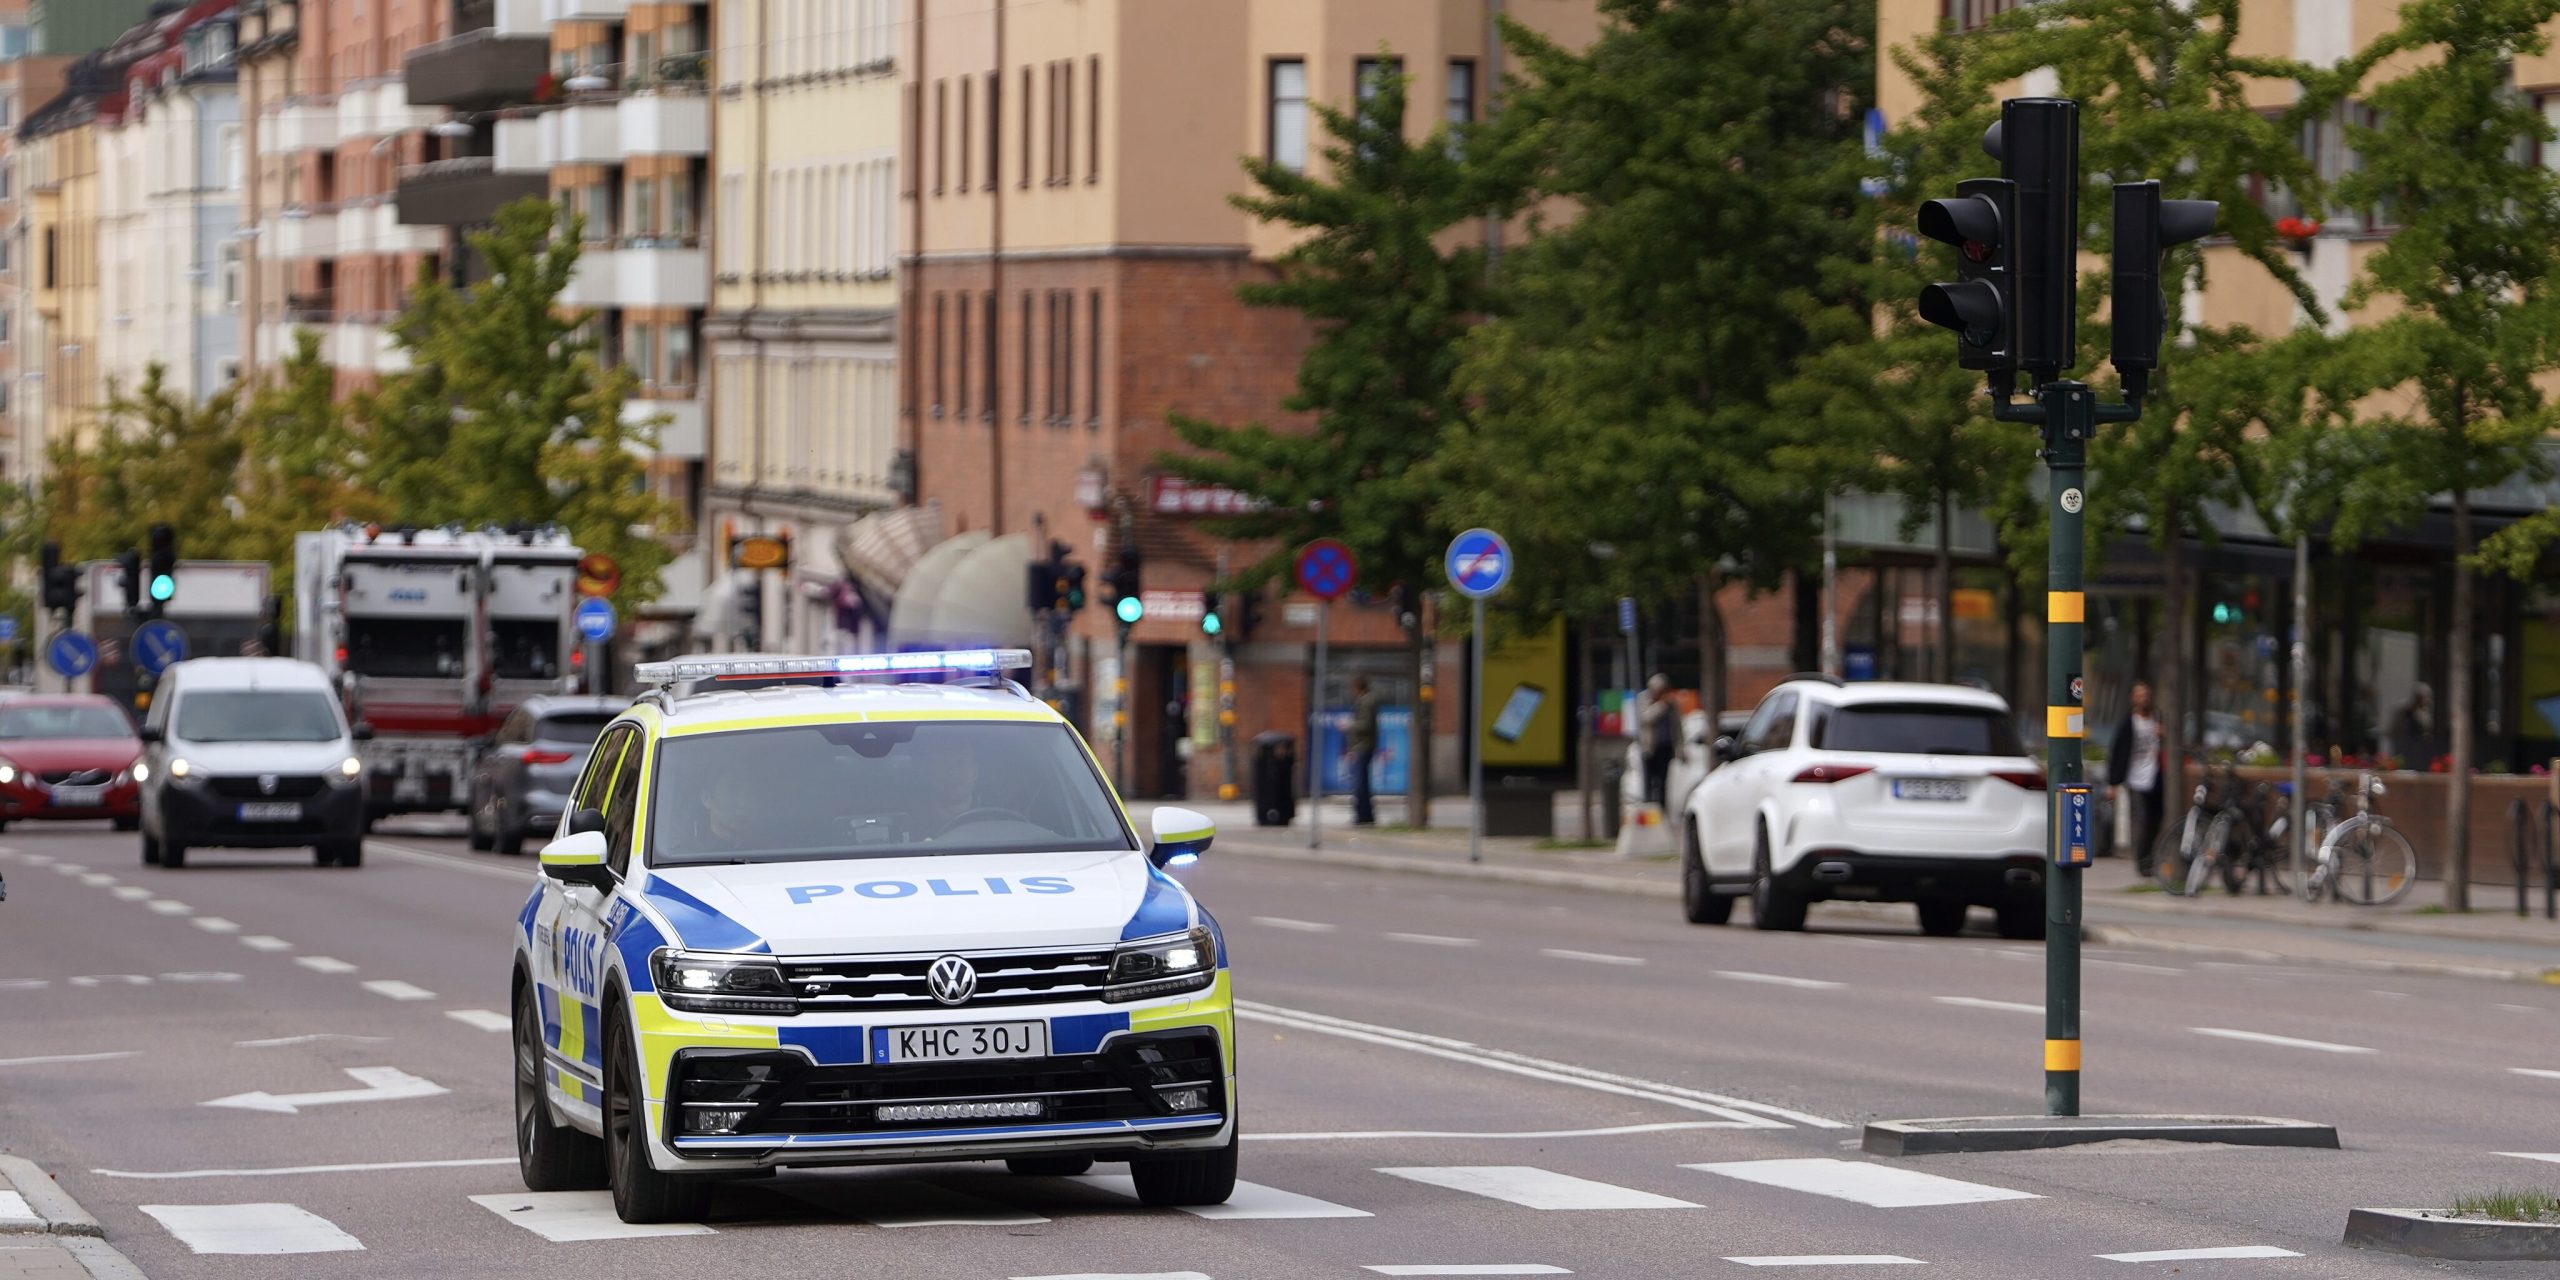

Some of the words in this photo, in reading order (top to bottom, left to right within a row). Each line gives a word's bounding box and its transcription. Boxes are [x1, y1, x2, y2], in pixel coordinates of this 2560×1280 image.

[785, 876, 1076, 905] POLIS
[564, 926, 597, 998] POLIS
[878, 1049, 885, 1058] S
[900, 1029, 960, 1058] KHC
[972, 1026, 1030, 1055] 30J
